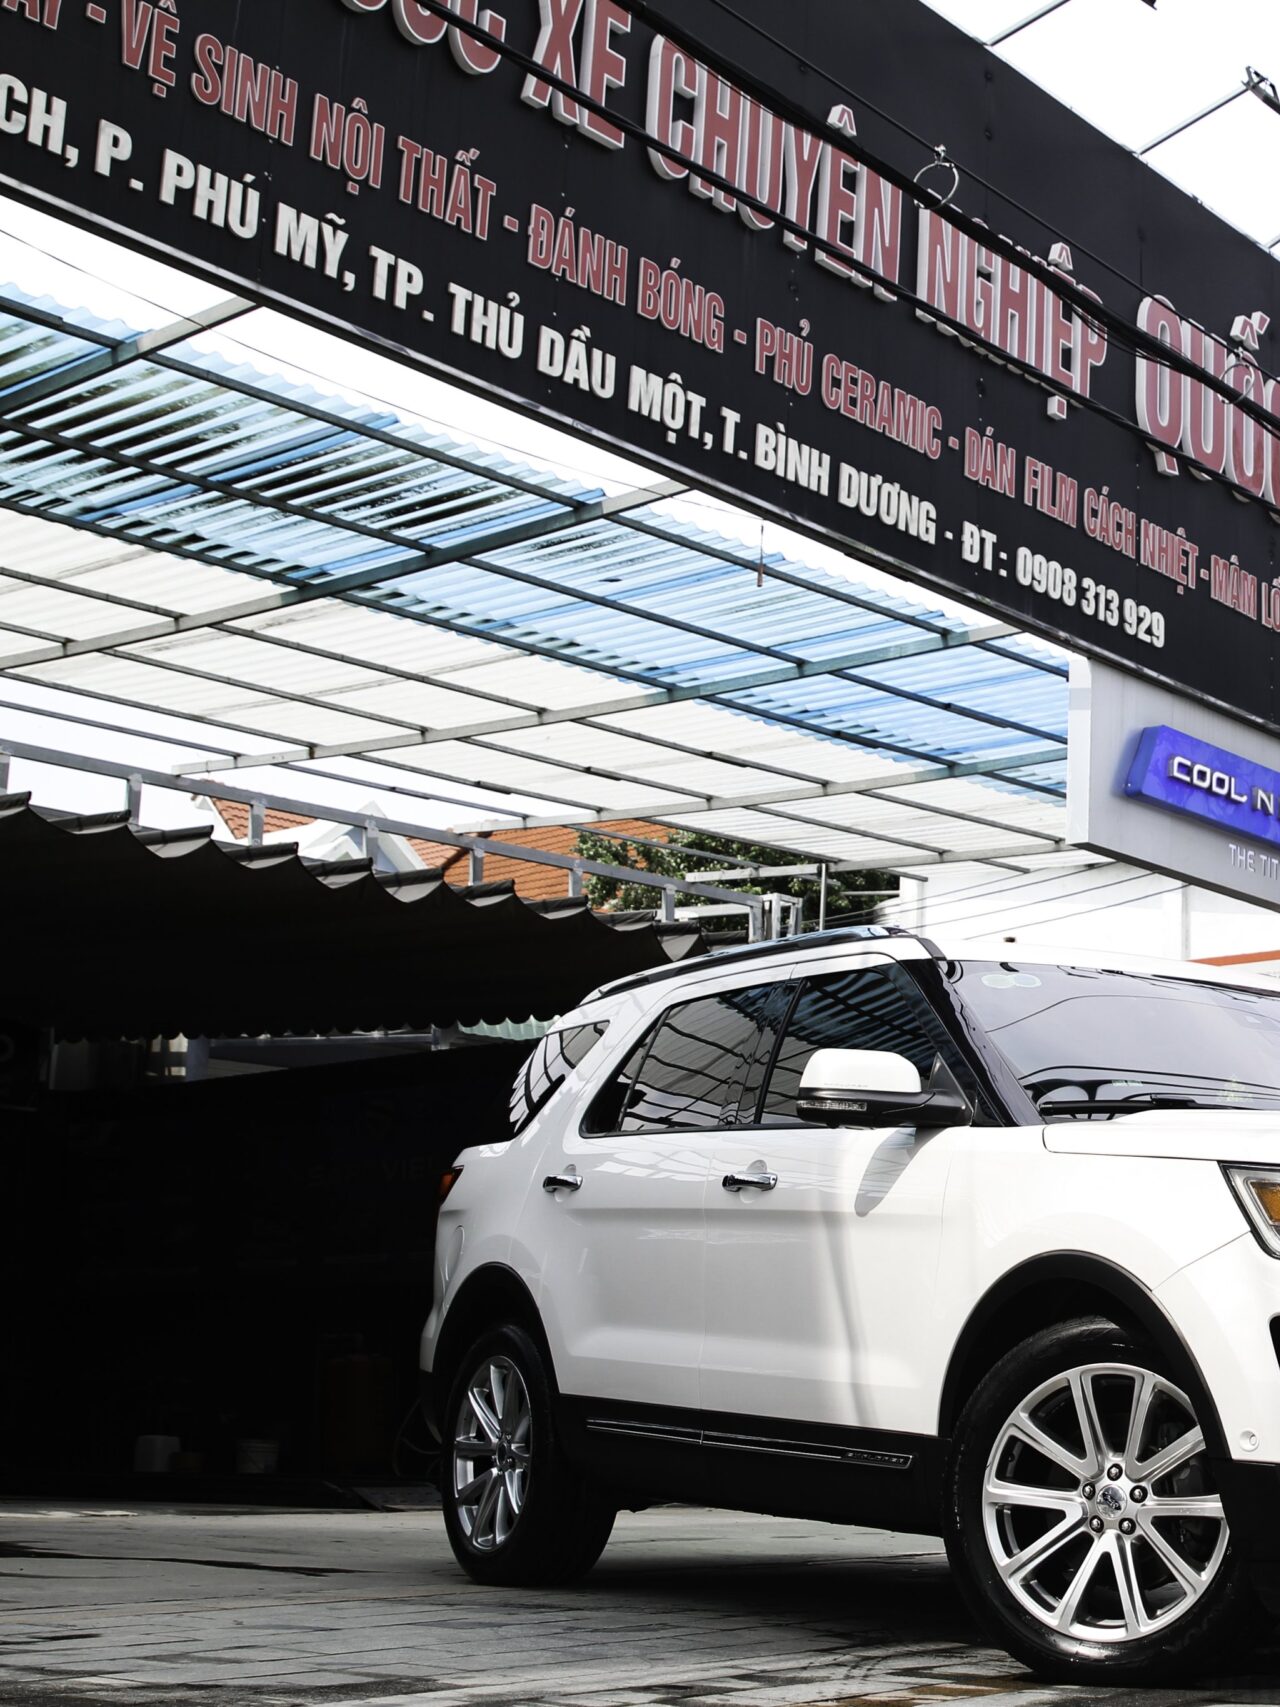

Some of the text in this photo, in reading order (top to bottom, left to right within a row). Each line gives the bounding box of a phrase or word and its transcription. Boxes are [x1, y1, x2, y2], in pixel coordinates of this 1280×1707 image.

[121, 0, 180, 97] VỆ
[191, 33, 298, 146] SINH
[310, 93, 385, 195] NỘI
[398, 136, 497, 241] THẤT
[527, 202, 628, 307] ĐÁNH
[637, 256, 725, 353] BÓNG
[754, 317, 814, 396] PHỦ
[822, 352, 943, 460] CERAMIC
[964, 426, 1016, 498] DÁN
[1024, 456, 1078, 529] FILM
[1083, 485, 1136, 559] CÁCH
[1140, 518, 1199, 595] NHIỆT
[1210, 554, 1258, 621] MÂM
[158, 147, 261, 240] PHÚ
[273, 201, 356, 293] MỸ,
[368, 244, 435, 322] TP.
[447, 281, 525, 360] THỦ
[536, 323, 617, 399] DẦU
[627, 364, 715, 450] MỘT,
[720, 406, 748, 461] T.
[754, 421, 830, 498] BÌNH
[838, 461, 938, 546] DƯƠNG
[961, 519, 1008, 578] ĐT:
[1016, 546, 1077, 607] 0908
[1081, 576, 1121, 630] 313
[1123, 597, 1167, 650] 929
[646, 34, 902, 301] CHUYÊN
[916, 189, 1107, 420] NGHIỆP
[1169, 755, 1248, 804] COOL
[1254, 786, 1275, 816] N
[1228, 843, 1256, 873] THE
